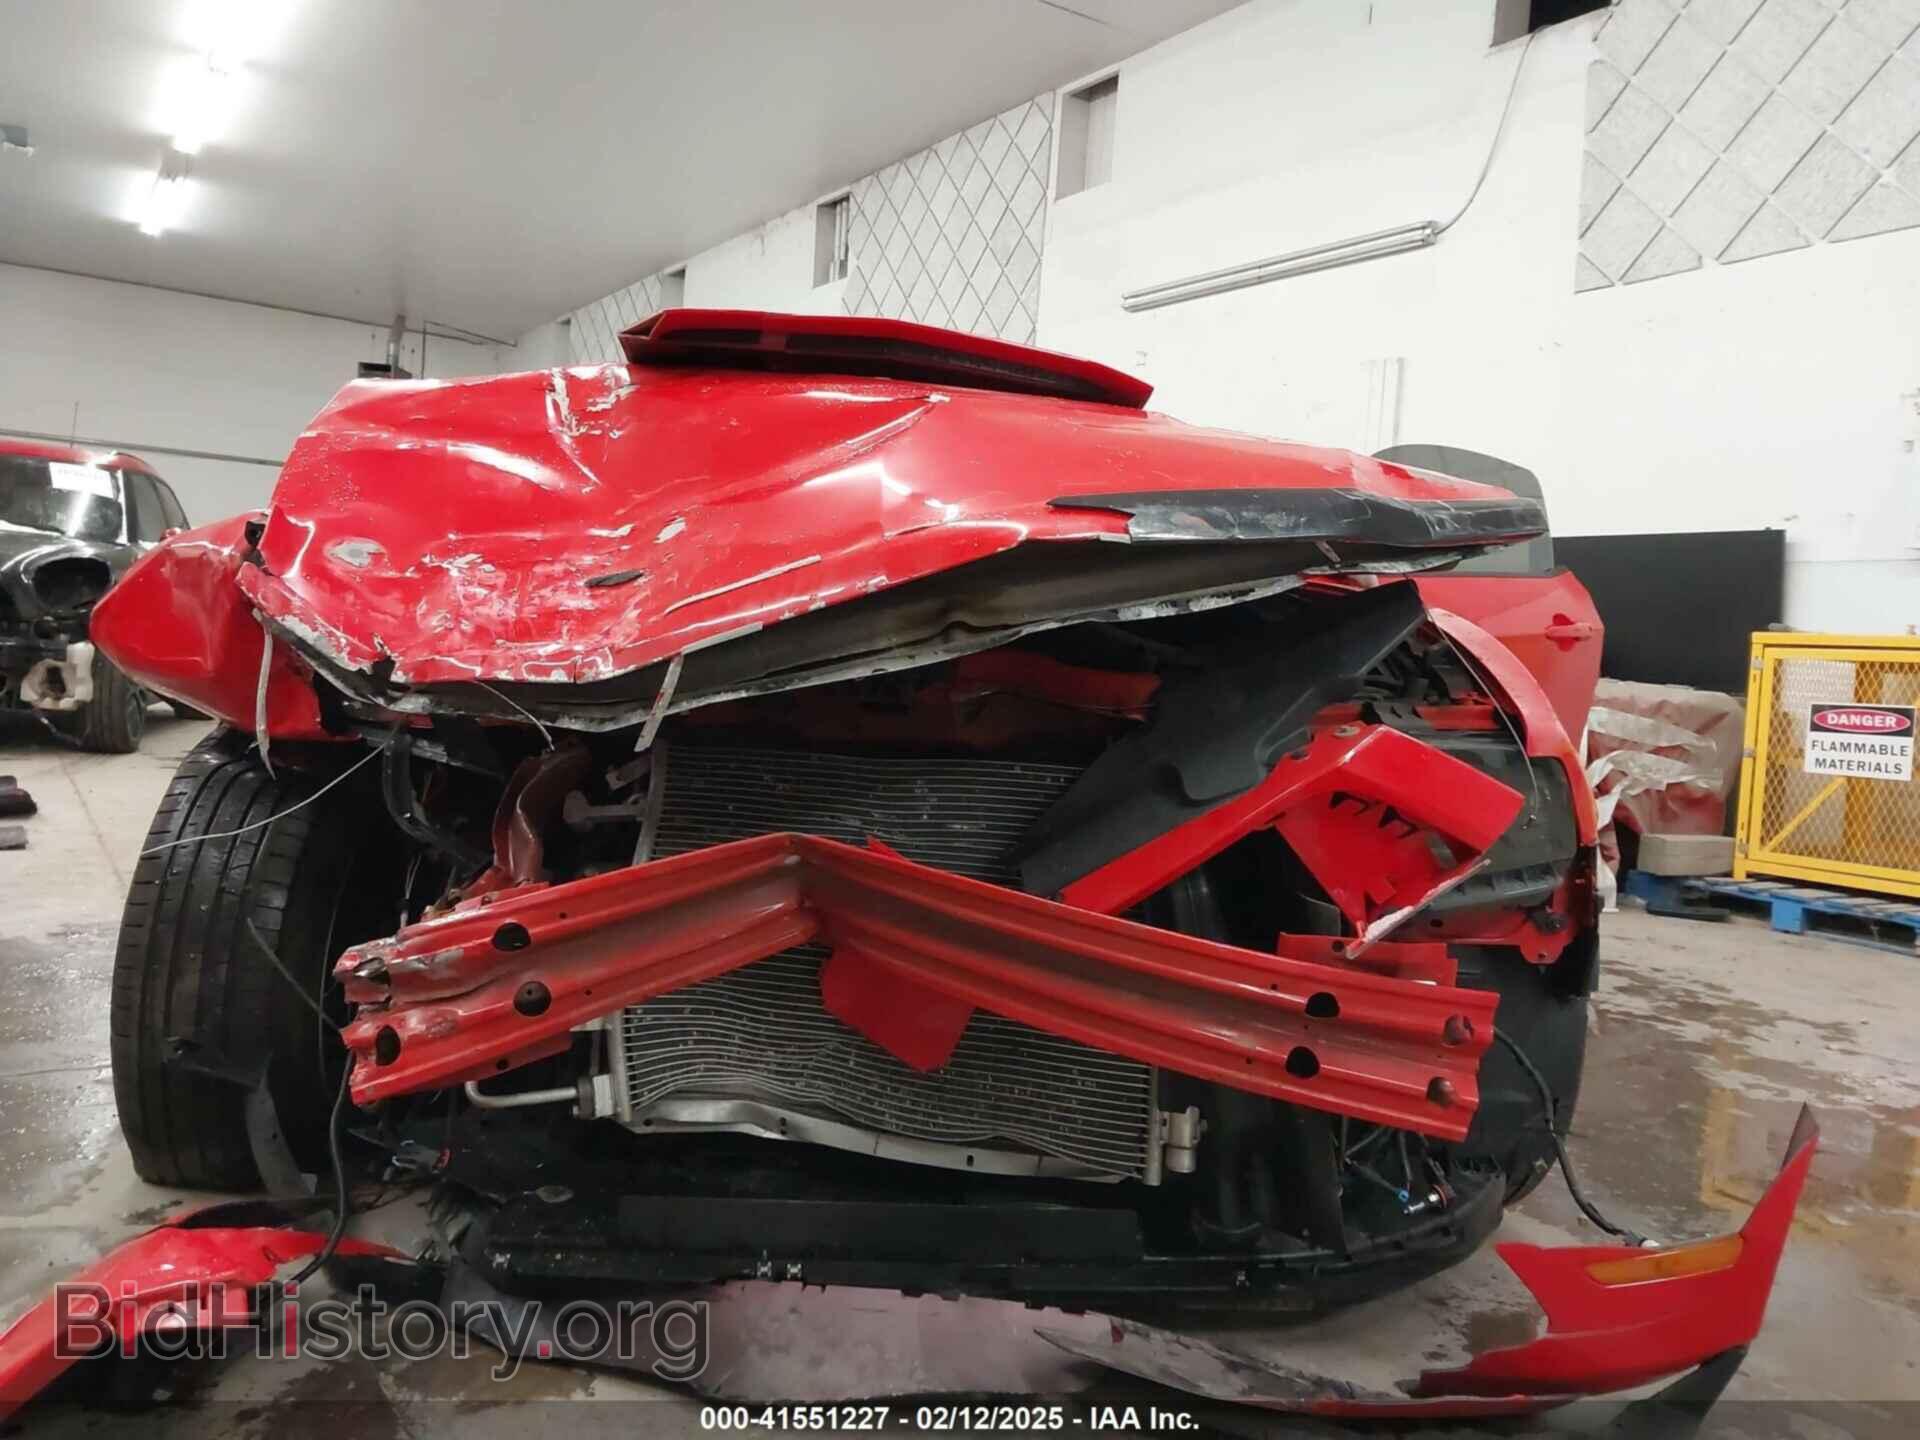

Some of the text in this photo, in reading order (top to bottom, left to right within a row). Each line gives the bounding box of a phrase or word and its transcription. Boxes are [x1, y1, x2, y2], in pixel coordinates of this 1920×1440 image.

[1827, 713, 1897, 728] DANGER
[1811, 739, 1909, 757] FLAMMABLE
[1814, 757, 1903, 775] MATERIALS
